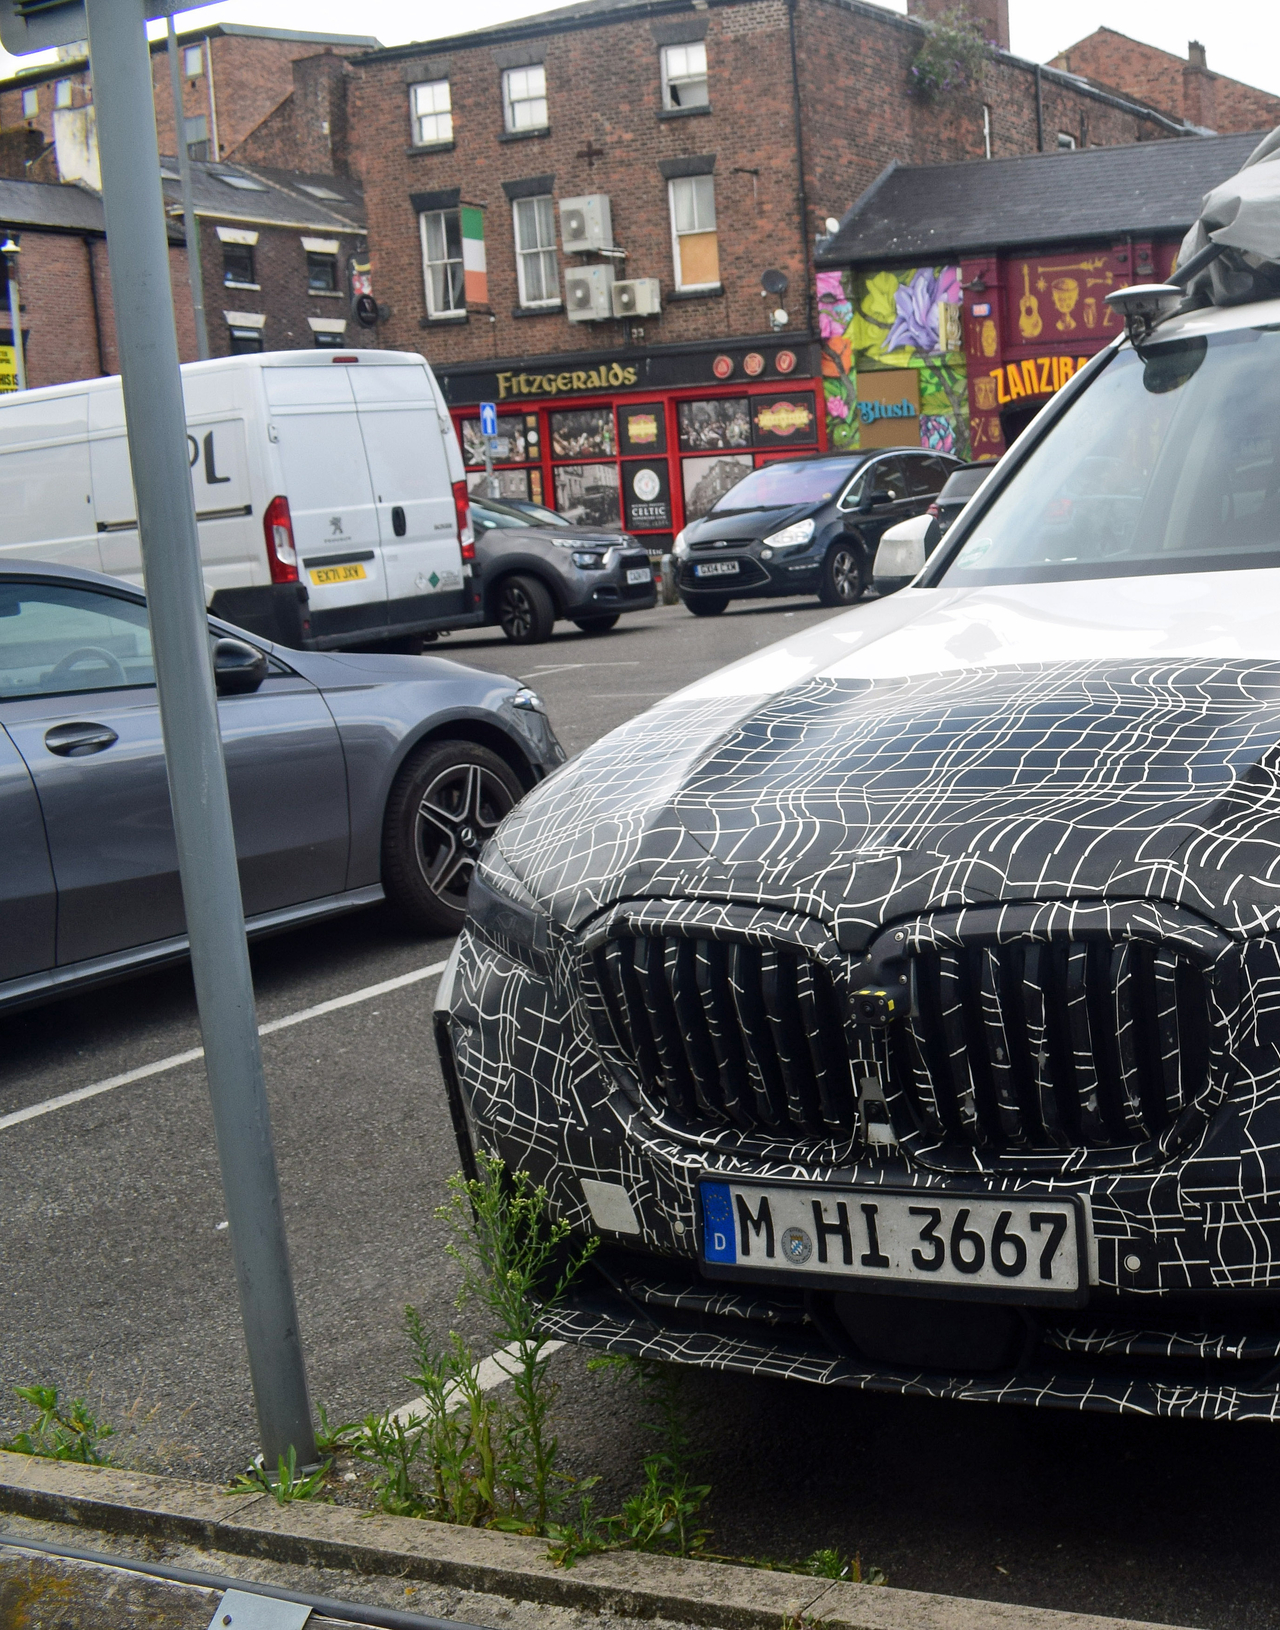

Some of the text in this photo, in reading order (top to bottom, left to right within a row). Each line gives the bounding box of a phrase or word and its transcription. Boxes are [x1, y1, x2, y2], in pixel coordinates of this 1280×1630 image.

[857, 398, 916, 425] Blush
[631, 506, 666, 517] CELTIC
[316, 566, 359, 582] EX71 JXV
[714, 1232, 726, 1251] D
[735, 1193, 775, 1258] M
[812, 1199, 890, 1268] HI
[908, 1205, 1068, 1280] 3667
